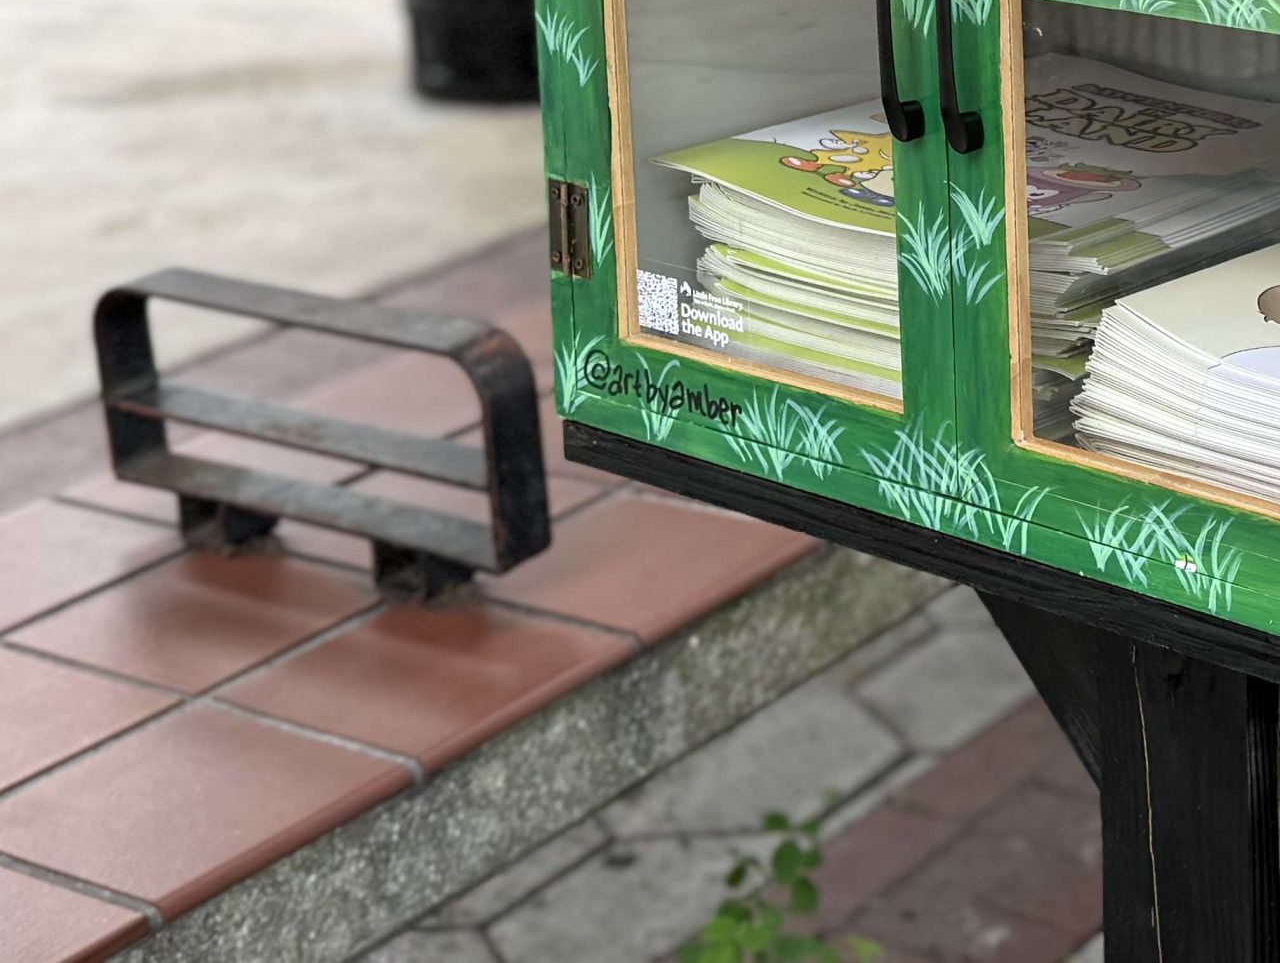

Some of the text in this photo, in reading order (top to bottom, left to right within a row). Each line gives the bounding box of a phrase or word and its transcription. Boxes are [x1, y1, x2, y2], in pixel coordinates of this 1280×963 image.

[681, 302, 744, 332] Download
[682, 318, 729, 348] the App
[584, 349, 743, 428] @artbyamber
